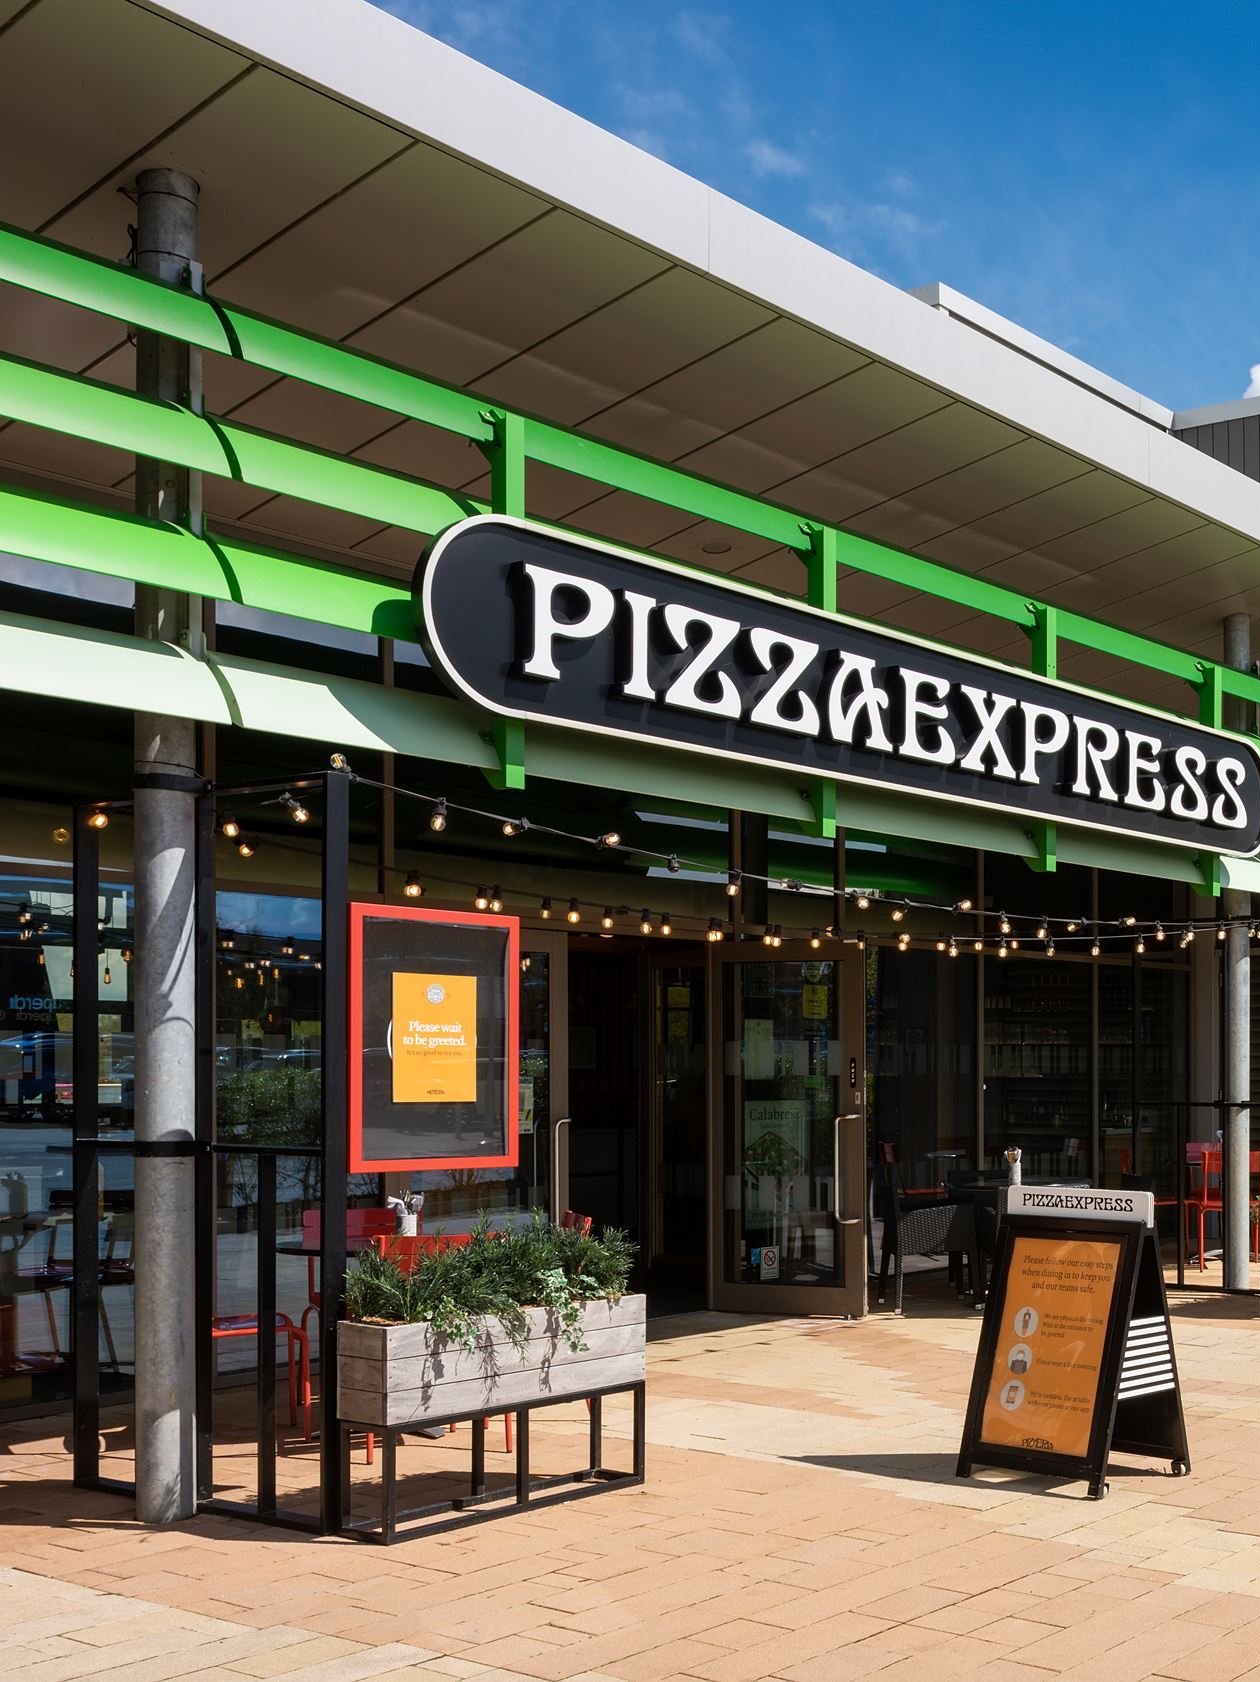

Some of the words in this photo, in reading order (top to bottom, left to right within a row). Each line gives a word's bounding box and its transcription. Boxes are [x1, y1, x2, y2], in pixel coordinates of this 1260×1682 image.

[523, 563, 1248, 829] PIZZAEXPRESS
[408, 1020, 440, 1032] Please
[440, 1021, 462, 1033] wait
[403, 1035, 413, 1045] to
[415, 1034, 428, 1045] be
[428, 1034, 467, 1048] greeted.
[1023, 1193, 1134, 1212] PIZZAEXPRESS
[1024, 1255, 1044, 1265] Please
[1045, 1256, 1066, 1266] follow
[1080, 1260, 1095, 1270] easy
[1096, 1262, 1114, 1271] steps
[1022, 1267, 1040, 1277] when
[1041, 1268, 1063, 1280] dining
[1064, 1270, 1071, 1279] in
[1072, 1272, 1080, 1280] to
[1080, 1272, 1097, 1283] keep
[1097, 1274, 1110, 1283] you
[1031, 1281, 1045, 1289] and
[1045, 1283, 1058, 1291] our
[1059, 1283, 1079, 1292] teams
